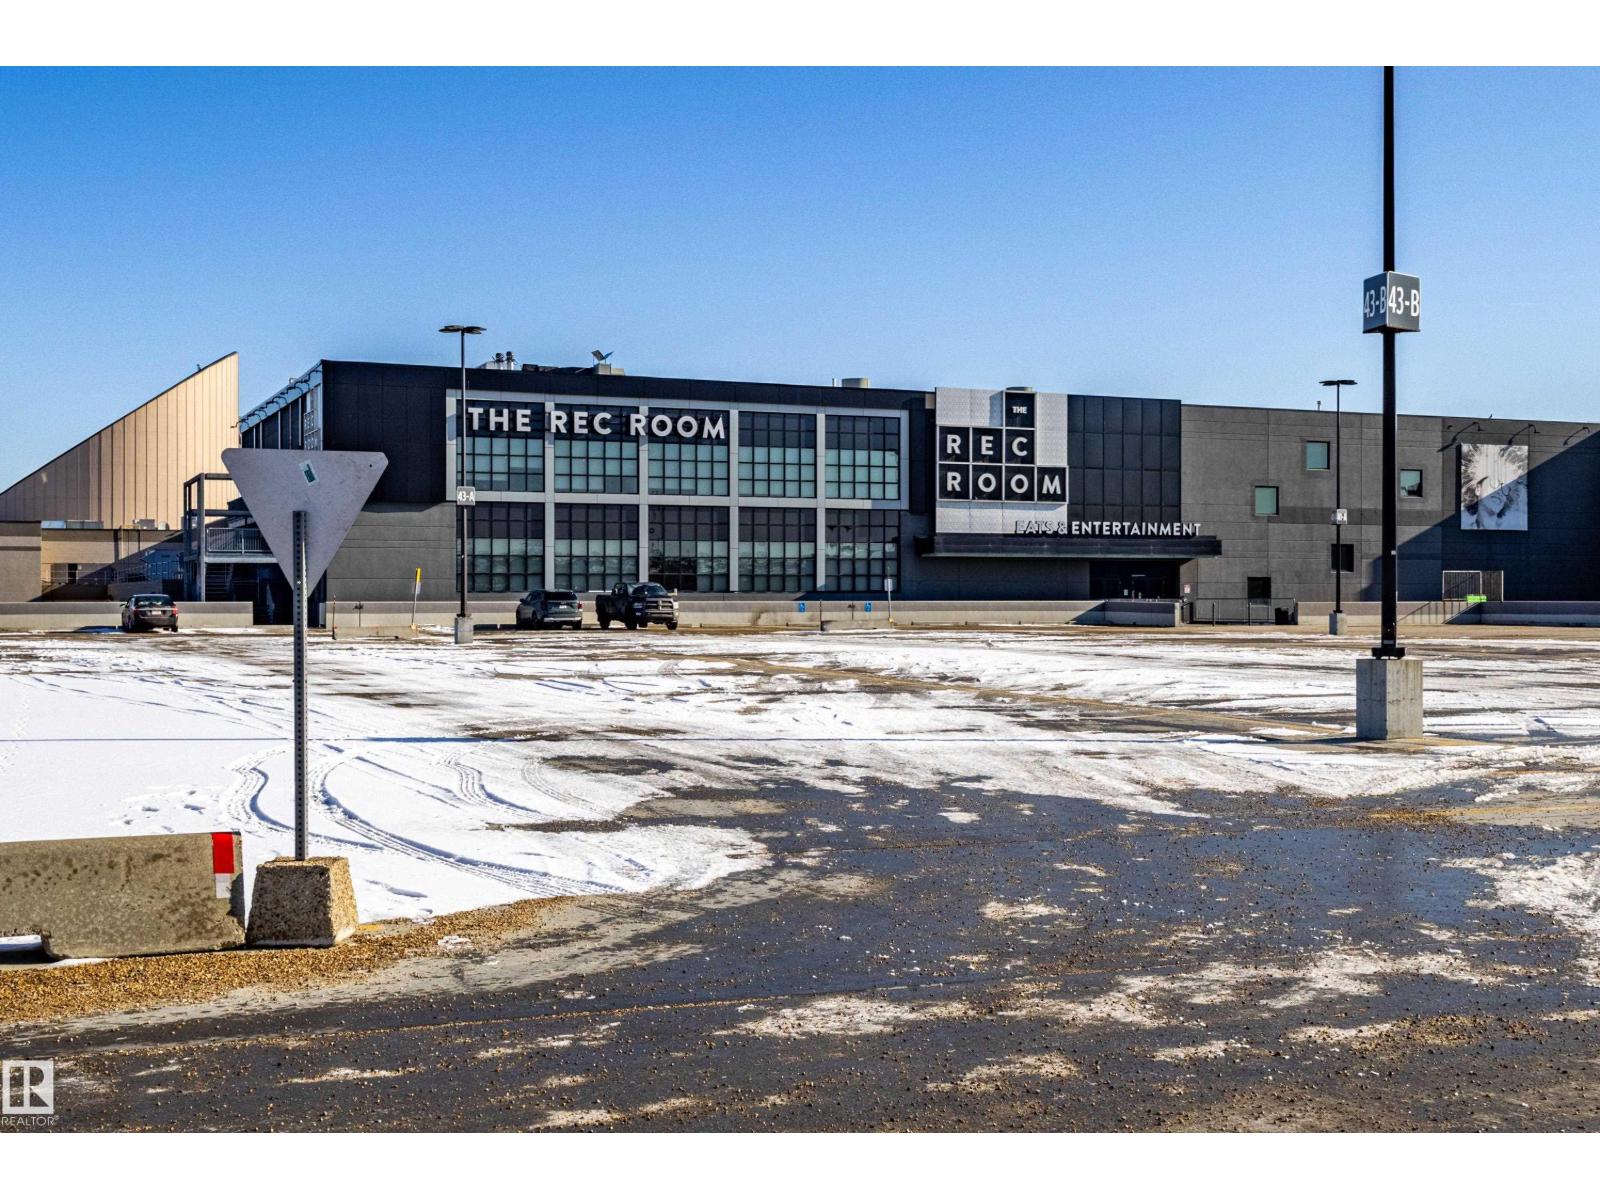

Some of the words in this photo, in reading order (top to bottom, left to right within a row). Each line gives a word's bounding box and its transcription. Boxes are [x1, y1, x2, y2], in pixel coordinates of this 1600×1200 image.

[1363, 286, 1387, 318] 43-B
[1388, 286, 1420, 317] 43-B
[1012, 406, 1028, 414] THE
[467, 407, 532, 432] THE
[550, 410, 612, 435] REC
[629, 413, 725, 439] ROOM
[946, 434, 1028, 456] REC
[946, 471, 1062, 495] ROOM
[458, 491, 475, 502] 43-A
[1014, 520, 1054, 534] EATS
[1057, 521, 1068, 534] &
[1071, 521, 1201, 536] ENTERTAINMENT
